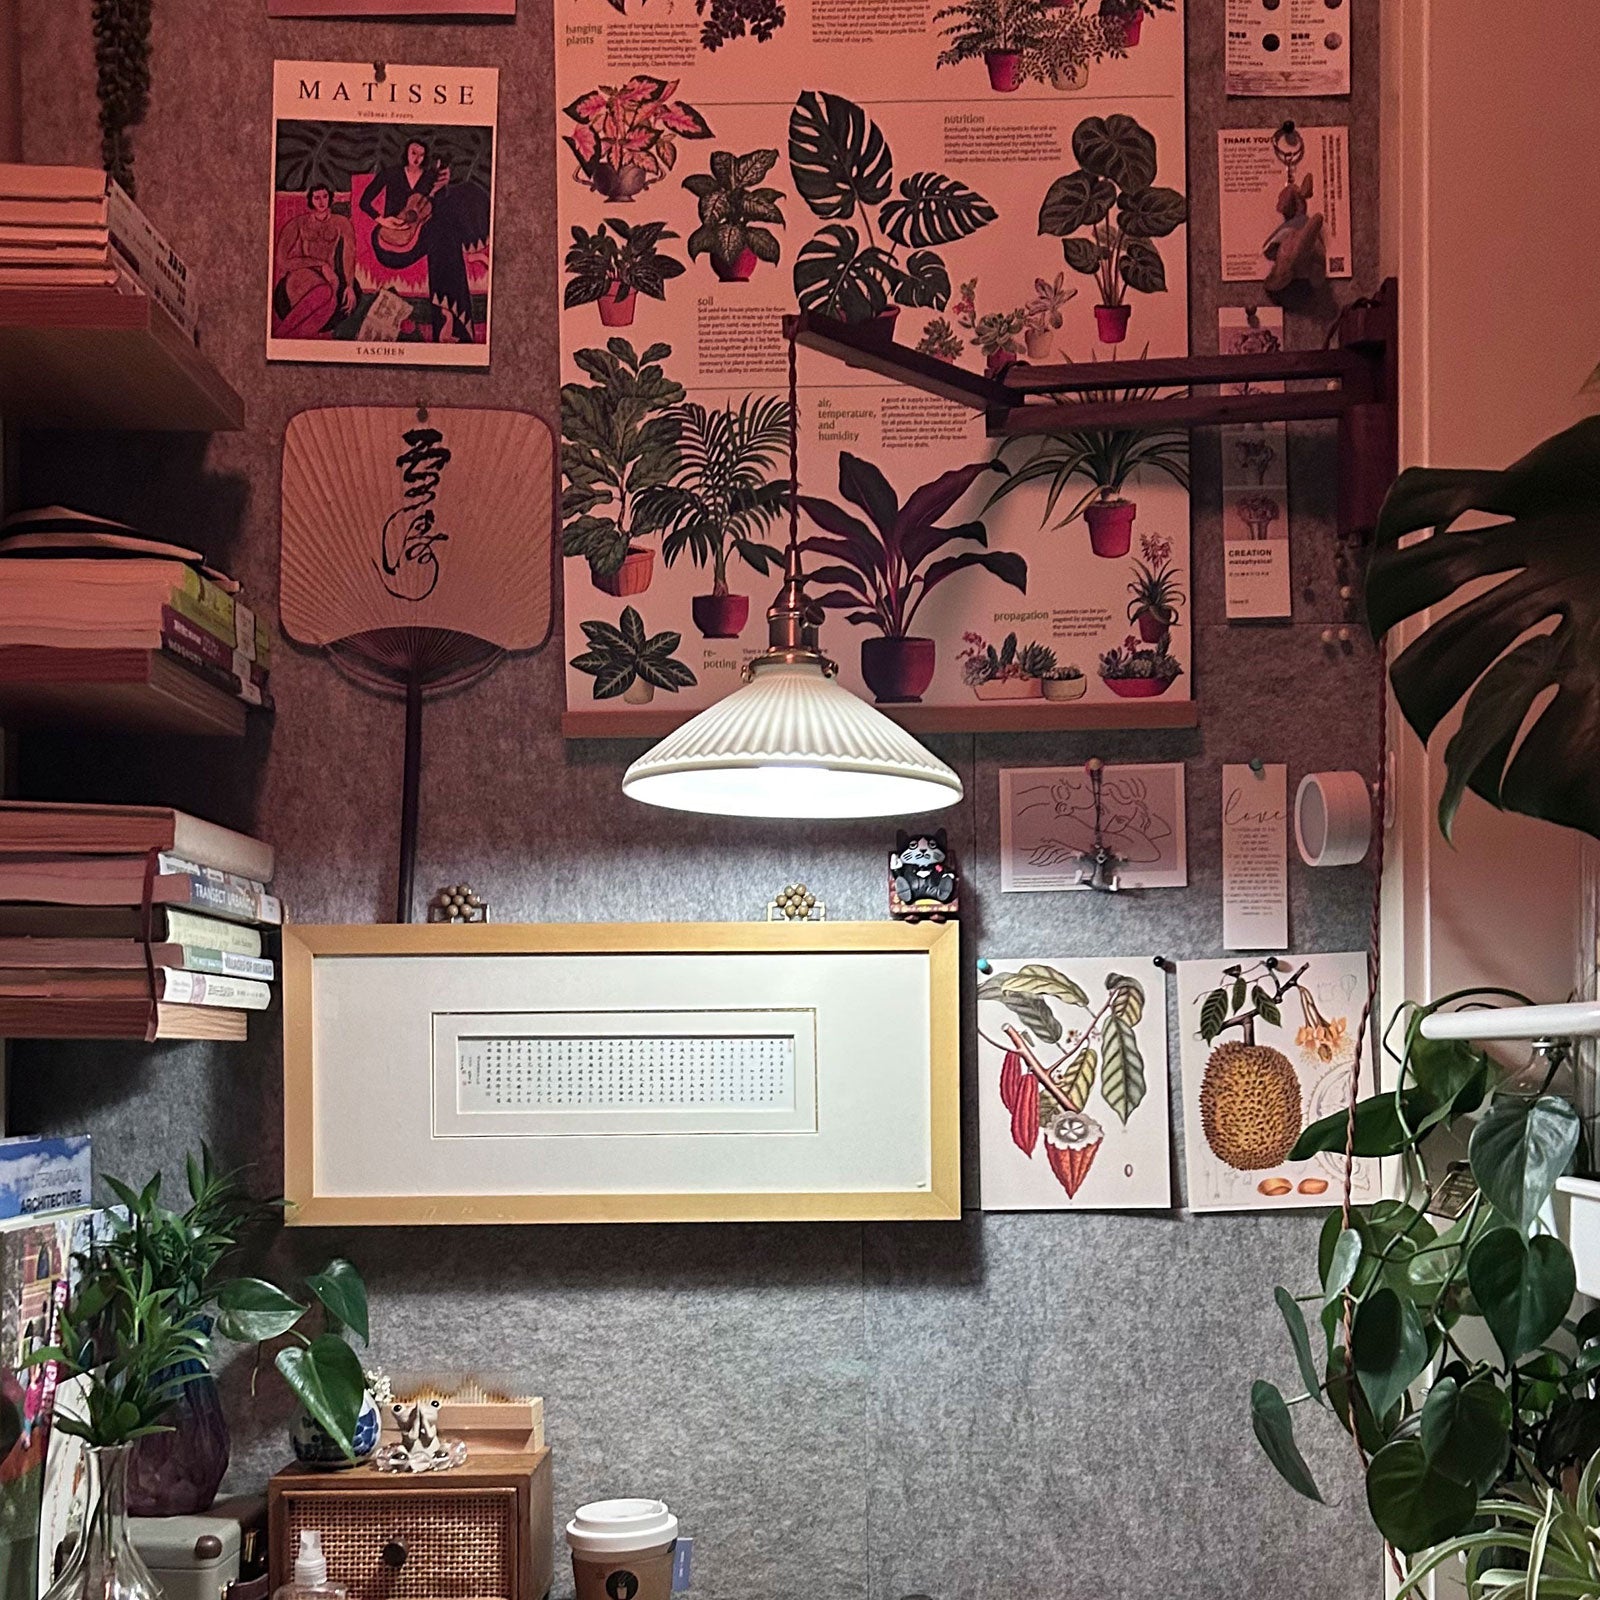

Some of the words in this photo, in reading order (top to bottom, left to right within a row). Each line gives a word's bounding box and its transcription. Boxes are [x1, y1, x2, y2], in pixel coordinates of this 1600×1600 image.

[566, 25, 602, 34] hanging
[566, 36, 594, 46] plants
[298, 80, 474, 106] MATISSE
[944, 114, 984, 124] nutrition
[698, 296, 713, 306] soil
[356, 347, 405, 356] TASCHEN
[818, 399, 832, 408] air,
[818, 410, 876, 420] temperature,
[818, 420, 835, 430] and
[818, 431, 859, 442] humidity
[1228, 549, 1272, 557] CREATION
[994, 611, 1049, 622] propagation
[703, 659, 736, 669] potting
[1224, 787, 1286, 825] love
[20, 1189, 82, 1213] ARCHITECTURE
